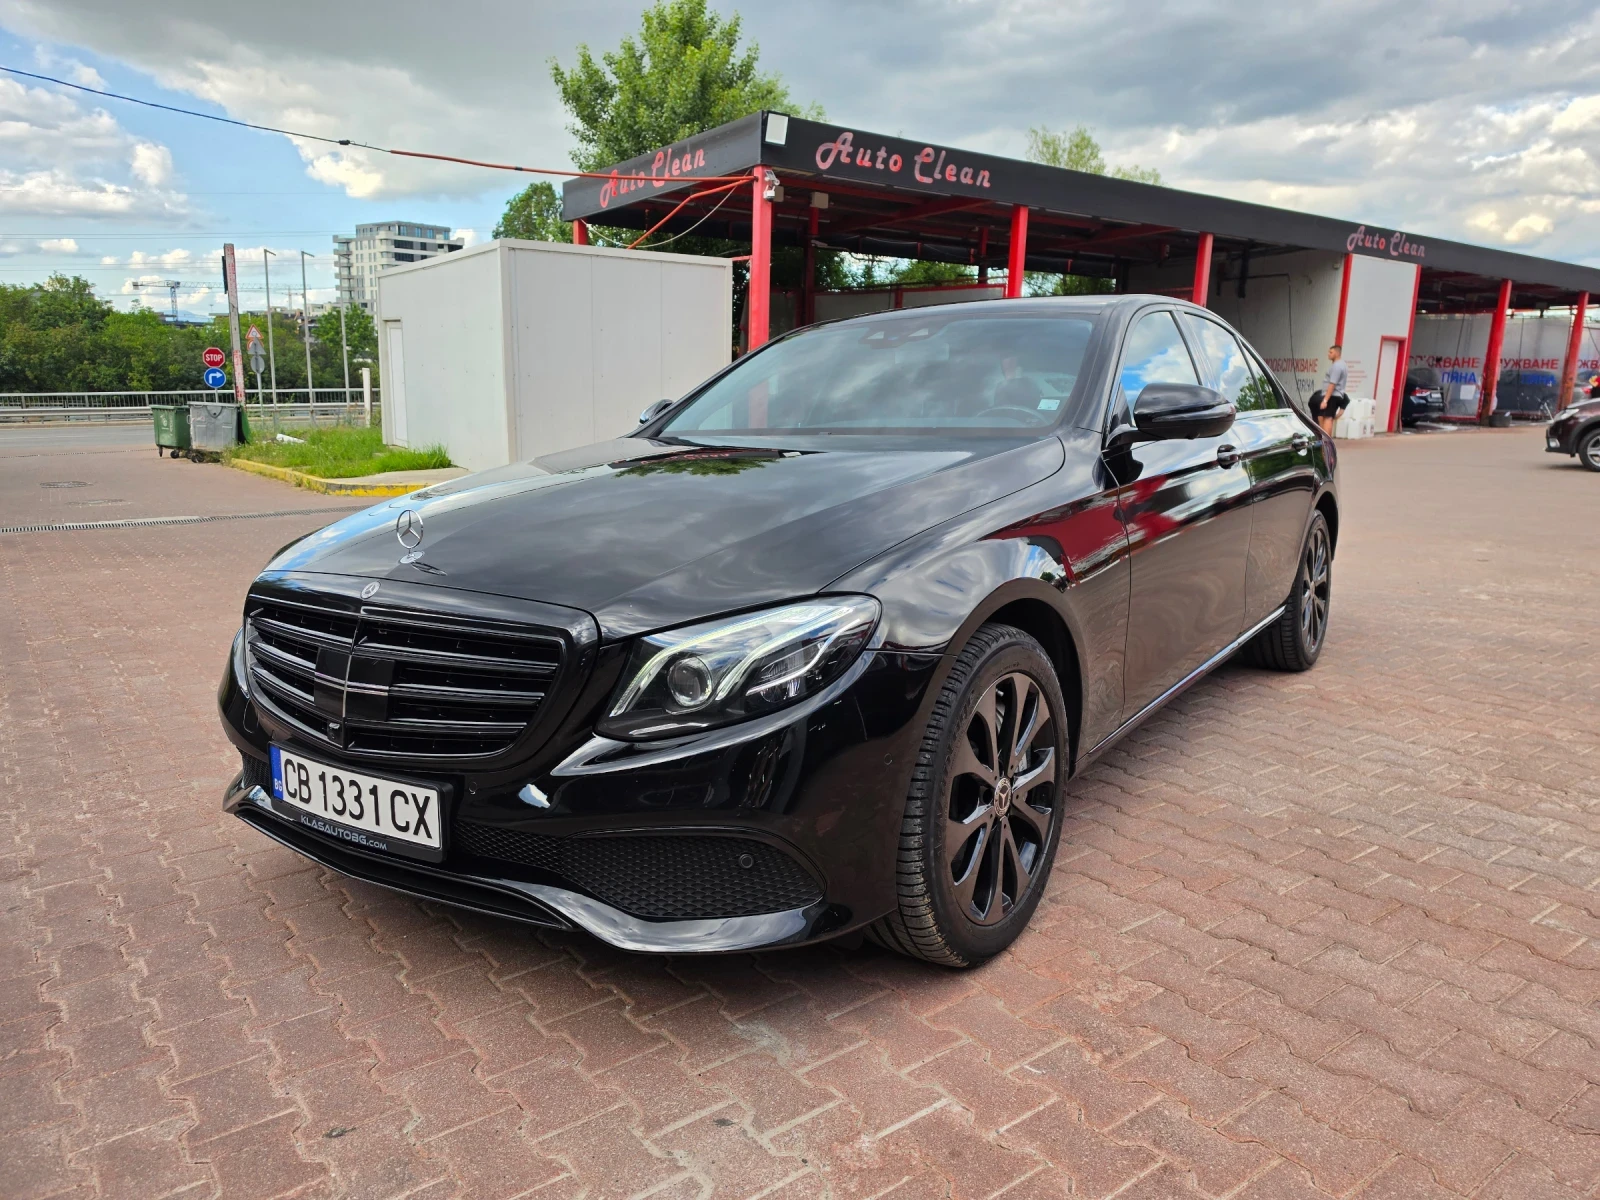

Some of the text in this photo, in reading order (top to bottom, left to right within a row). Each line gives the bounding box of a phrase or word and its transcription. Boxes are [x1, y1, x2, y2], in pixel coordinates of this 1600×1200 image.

[600, 148, 705, 208] Auto Clean
[816, 131, 991, 188] Auto Clean
[1347, 225, 1425, 258] Auto Clean
[205, 353, 223, 362] STOP
[274, 778, 283, 792] BG
[284, 758, 433, 840] CB 1331 CX
